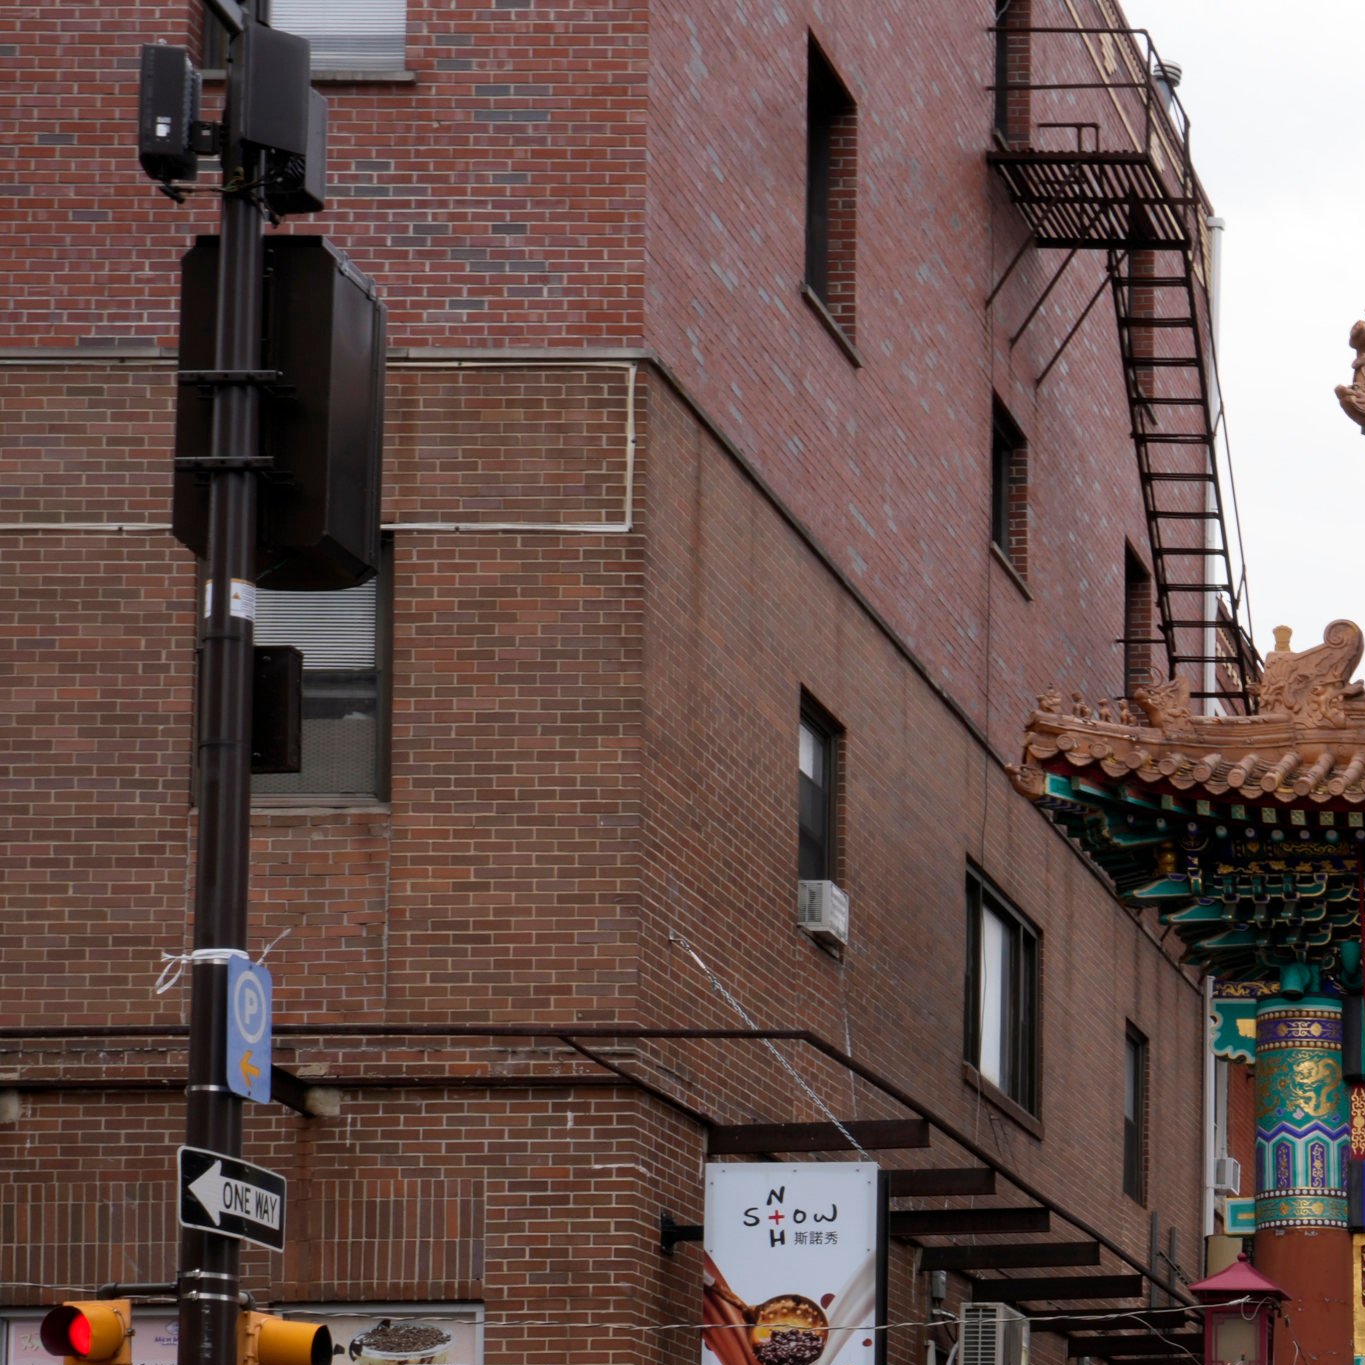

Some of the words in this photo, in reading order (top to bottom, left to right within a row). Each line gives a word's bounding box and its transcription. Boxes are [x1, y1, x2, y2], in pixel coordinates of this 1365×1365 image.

[222, 1181, 251, 1215] ONE
[255, 1190, 278, 1225] WAY
[794, 1231, 838, 1245] 斯諾秀
